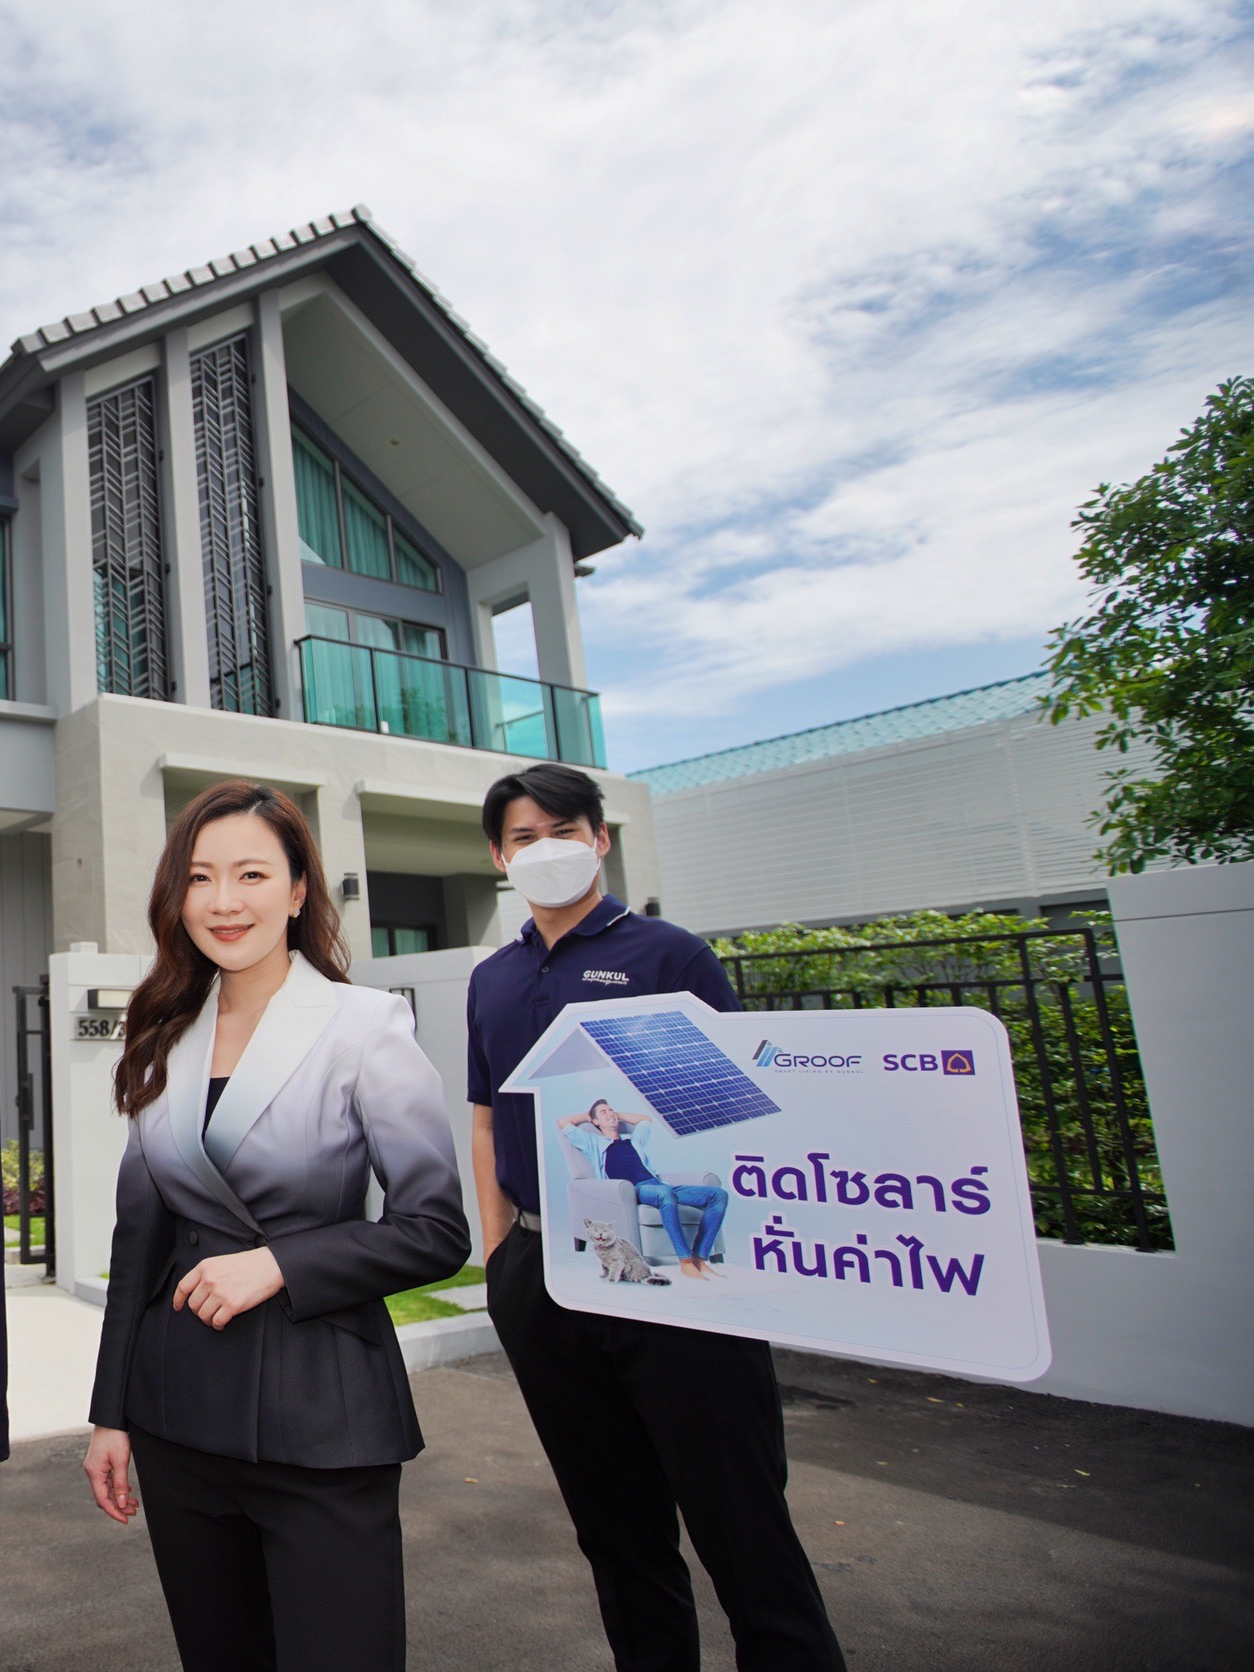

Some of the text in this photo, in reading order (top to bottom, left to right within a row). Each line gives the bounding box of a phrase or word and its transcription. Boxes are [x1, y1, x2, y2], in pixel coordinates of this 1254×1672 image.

[583, 970, 629, 981] GUNKUL
[774, 1053, 862, 1067] GROOF
[882, 1053, 938, 1071] SCB
[731, 1152, 992, 1216] ติดโซลาร์
[752, 1215, 985, 1297] หั่นค่าไฟ
